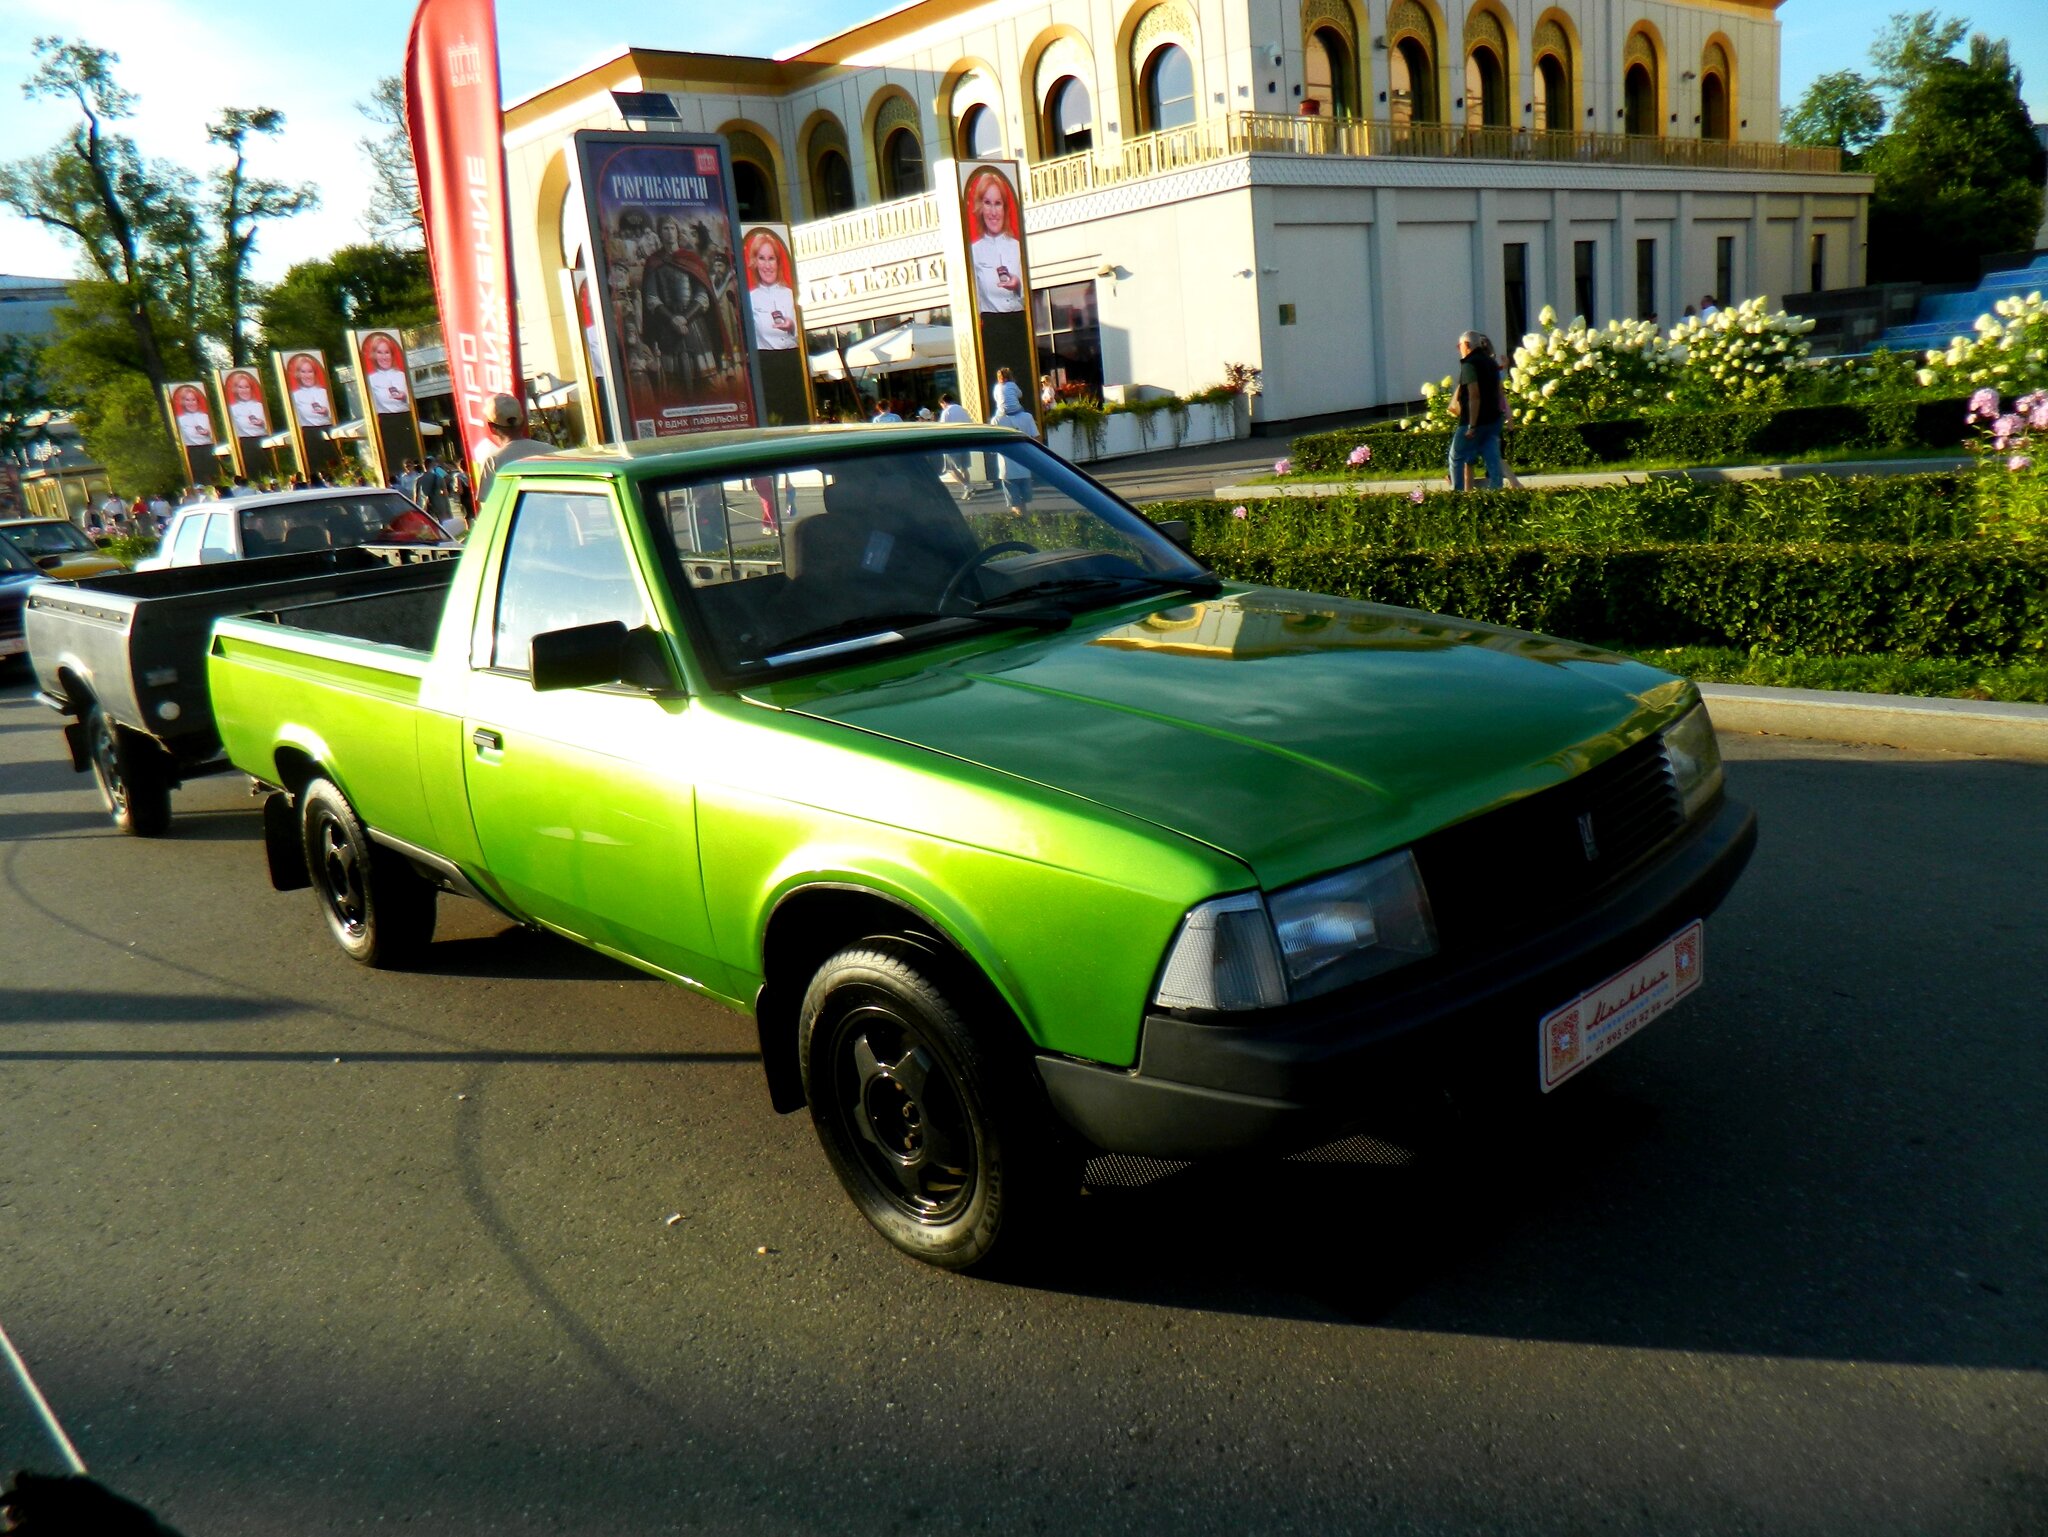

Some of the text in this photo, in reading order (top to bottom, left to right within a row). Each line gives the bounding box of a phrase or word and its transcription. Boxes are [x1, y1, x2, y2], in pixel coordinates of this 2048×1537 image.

[452, 72, 482, 88] ВДНХ
[467, 156, 503, 394] ВИЖЕНИЕ
[459, 332, 485, 428] ПРО
[665, 419, 688, 428] ВДНХ
[693, 415, 739, 425] ПАВИЛЬОН
